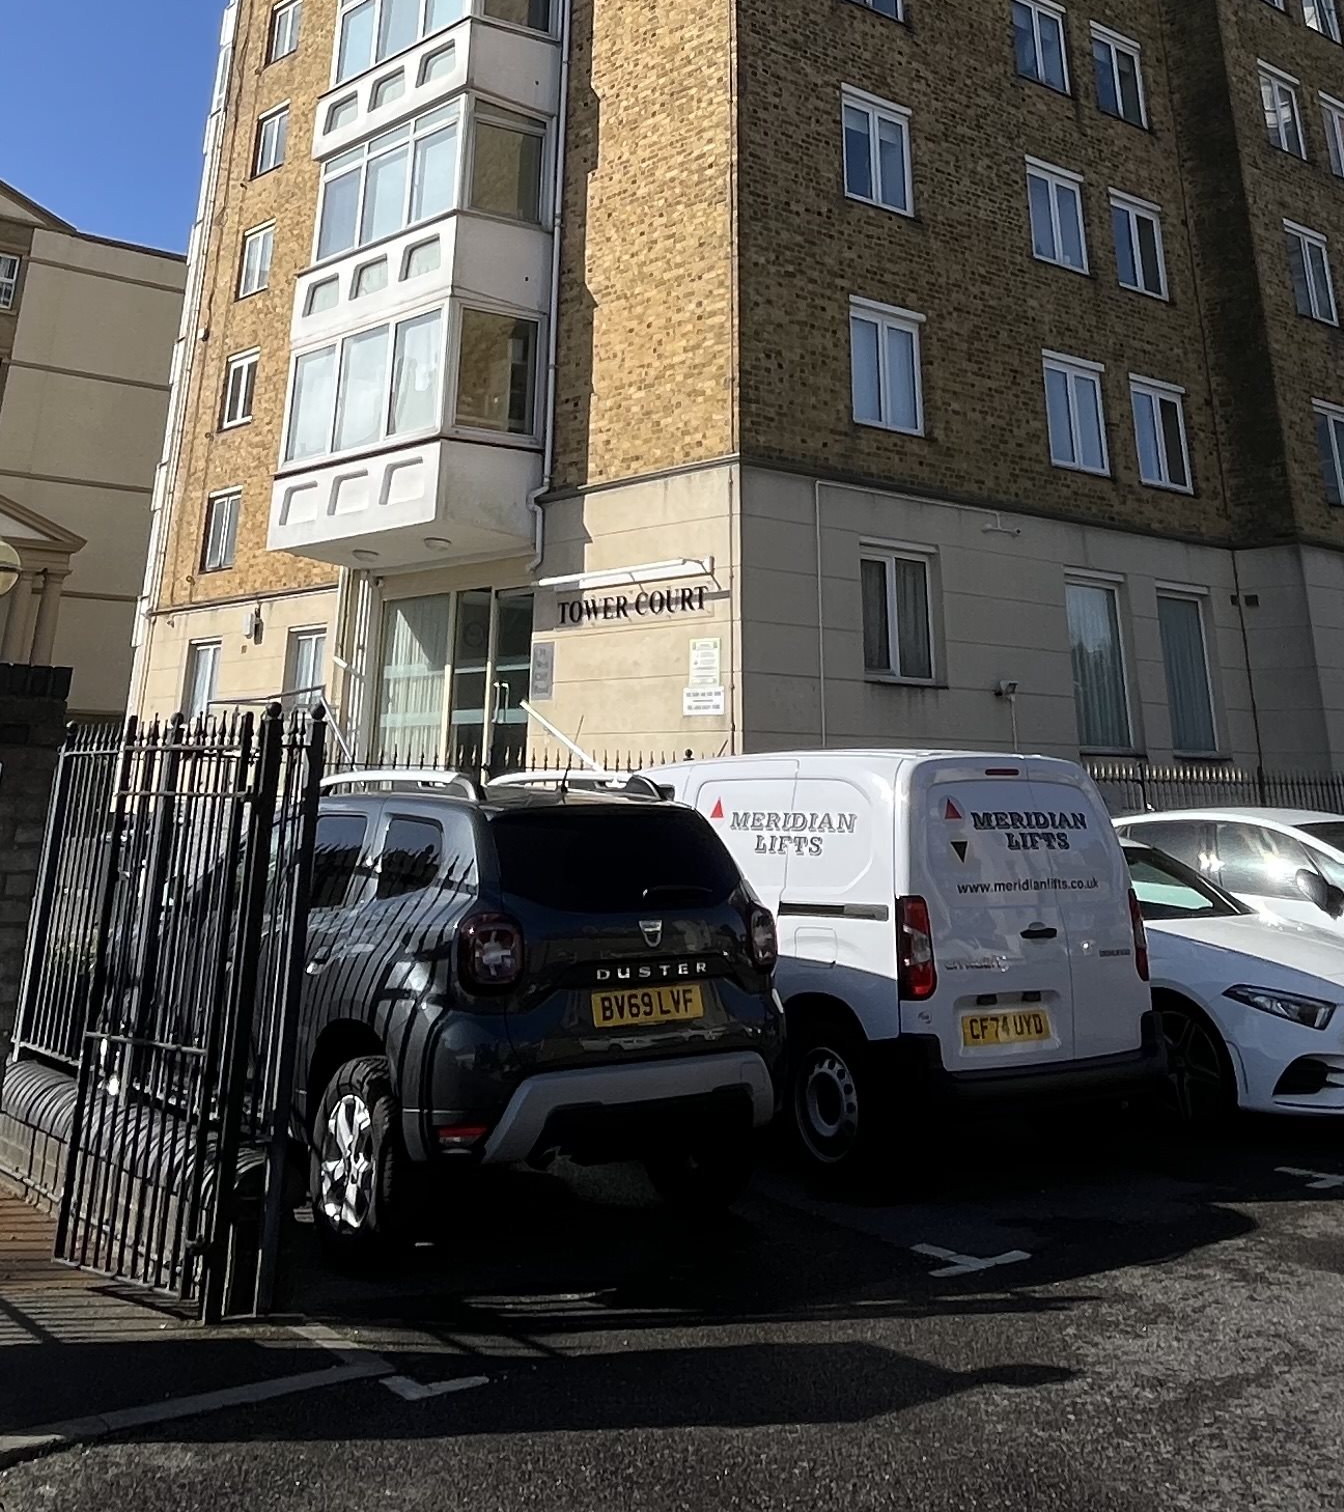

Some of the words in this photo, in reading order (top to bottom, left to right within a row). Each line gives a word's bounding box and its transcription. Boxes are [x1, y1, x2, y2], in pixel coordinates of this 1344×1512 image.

[558, 595, 629, 625] TOWER
[635, 585, 709, 616] COURT
[730, 811, 857, 833] MERIDIAN
[970, 811, 1088, 830] MERIDIAN
[755, 834, 823, 856] LIFTS
[1005, 832, 1070, 850] LIFTS
[956, 876, 1099, 894] www.meridianlifts.co.uk
[596, 962, 707, 980] DUSTER
[600, 992, 654, 1021] BV69
[657, 989, 693, 1015] LVF
[969, 1016, 1010, 1040] CF74
[1013, 1013, 1044, 1036] UYD
